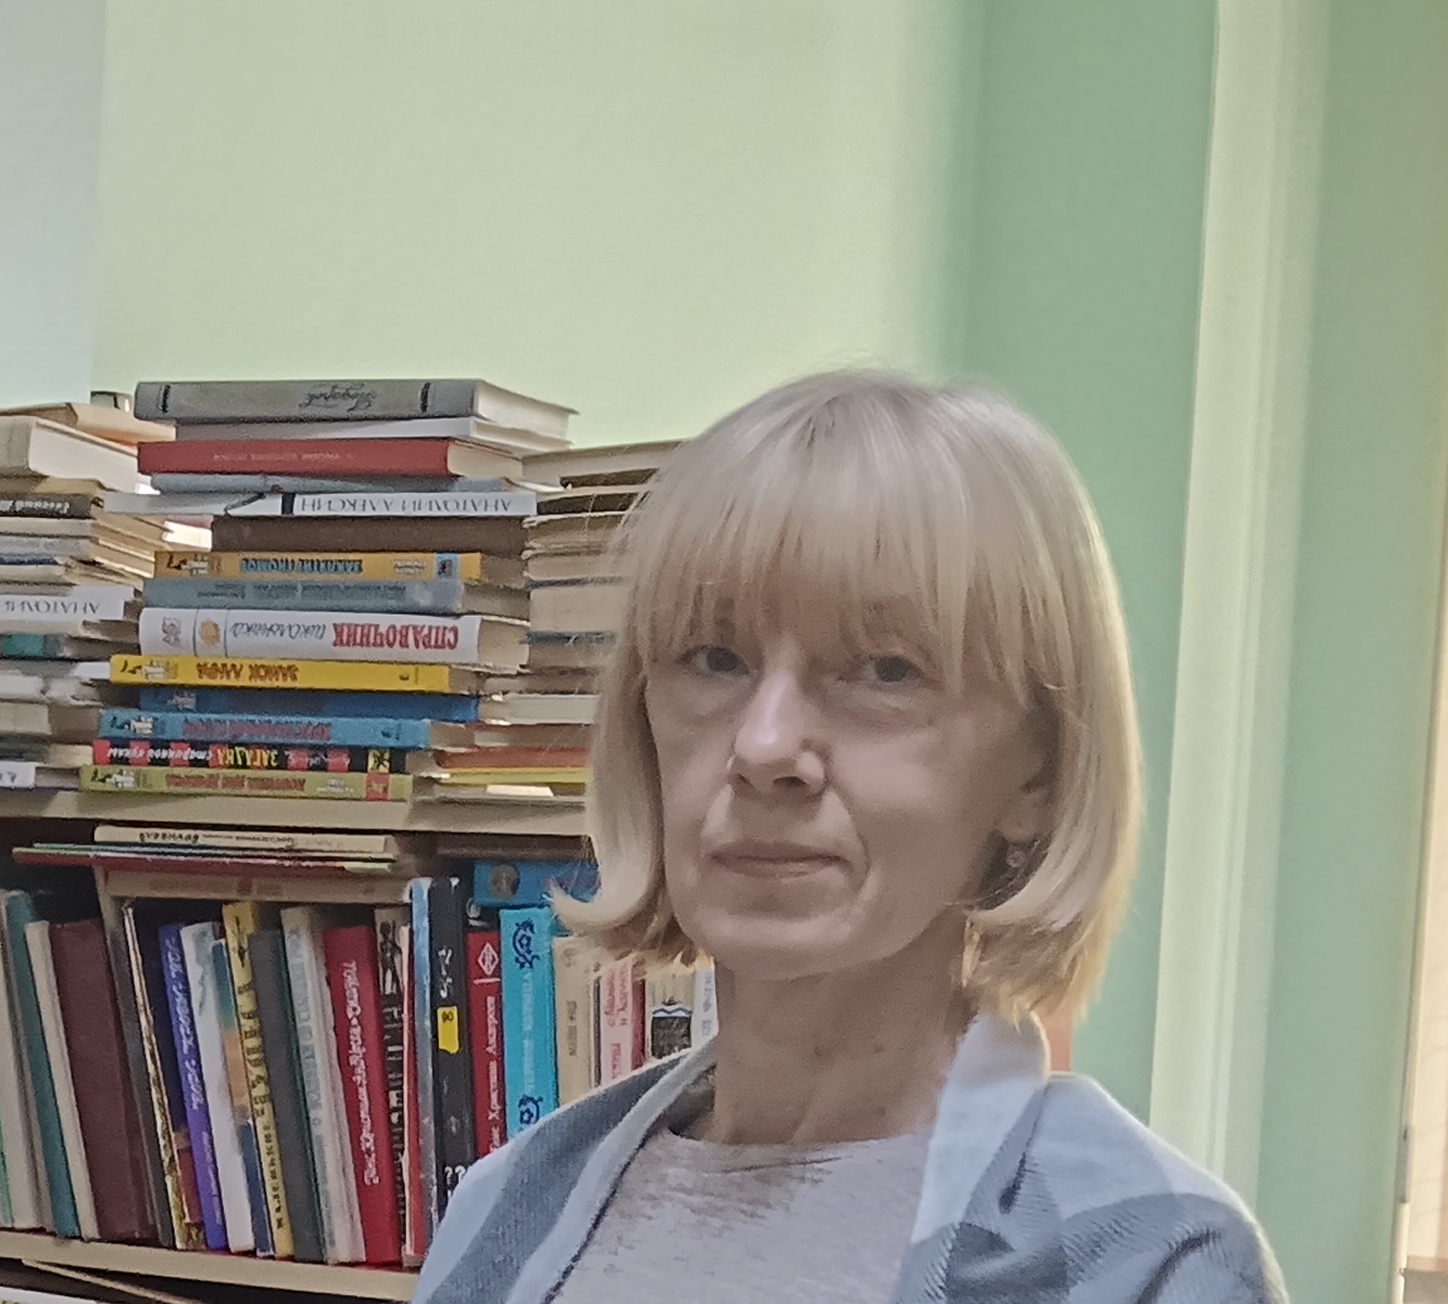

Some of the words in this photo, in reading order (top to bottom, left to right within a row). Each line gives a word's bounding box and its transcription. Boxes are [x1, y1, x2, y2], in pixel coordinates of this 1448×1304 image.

[300, 497, 394, 514] АЛЕКСИН
[401, 497, 514, 514] АНАТОЛИЙ
[331, 622, 460, 651] СПРАВОЧНИК
[216, 748, 279, 768] ЗАГАДКА
